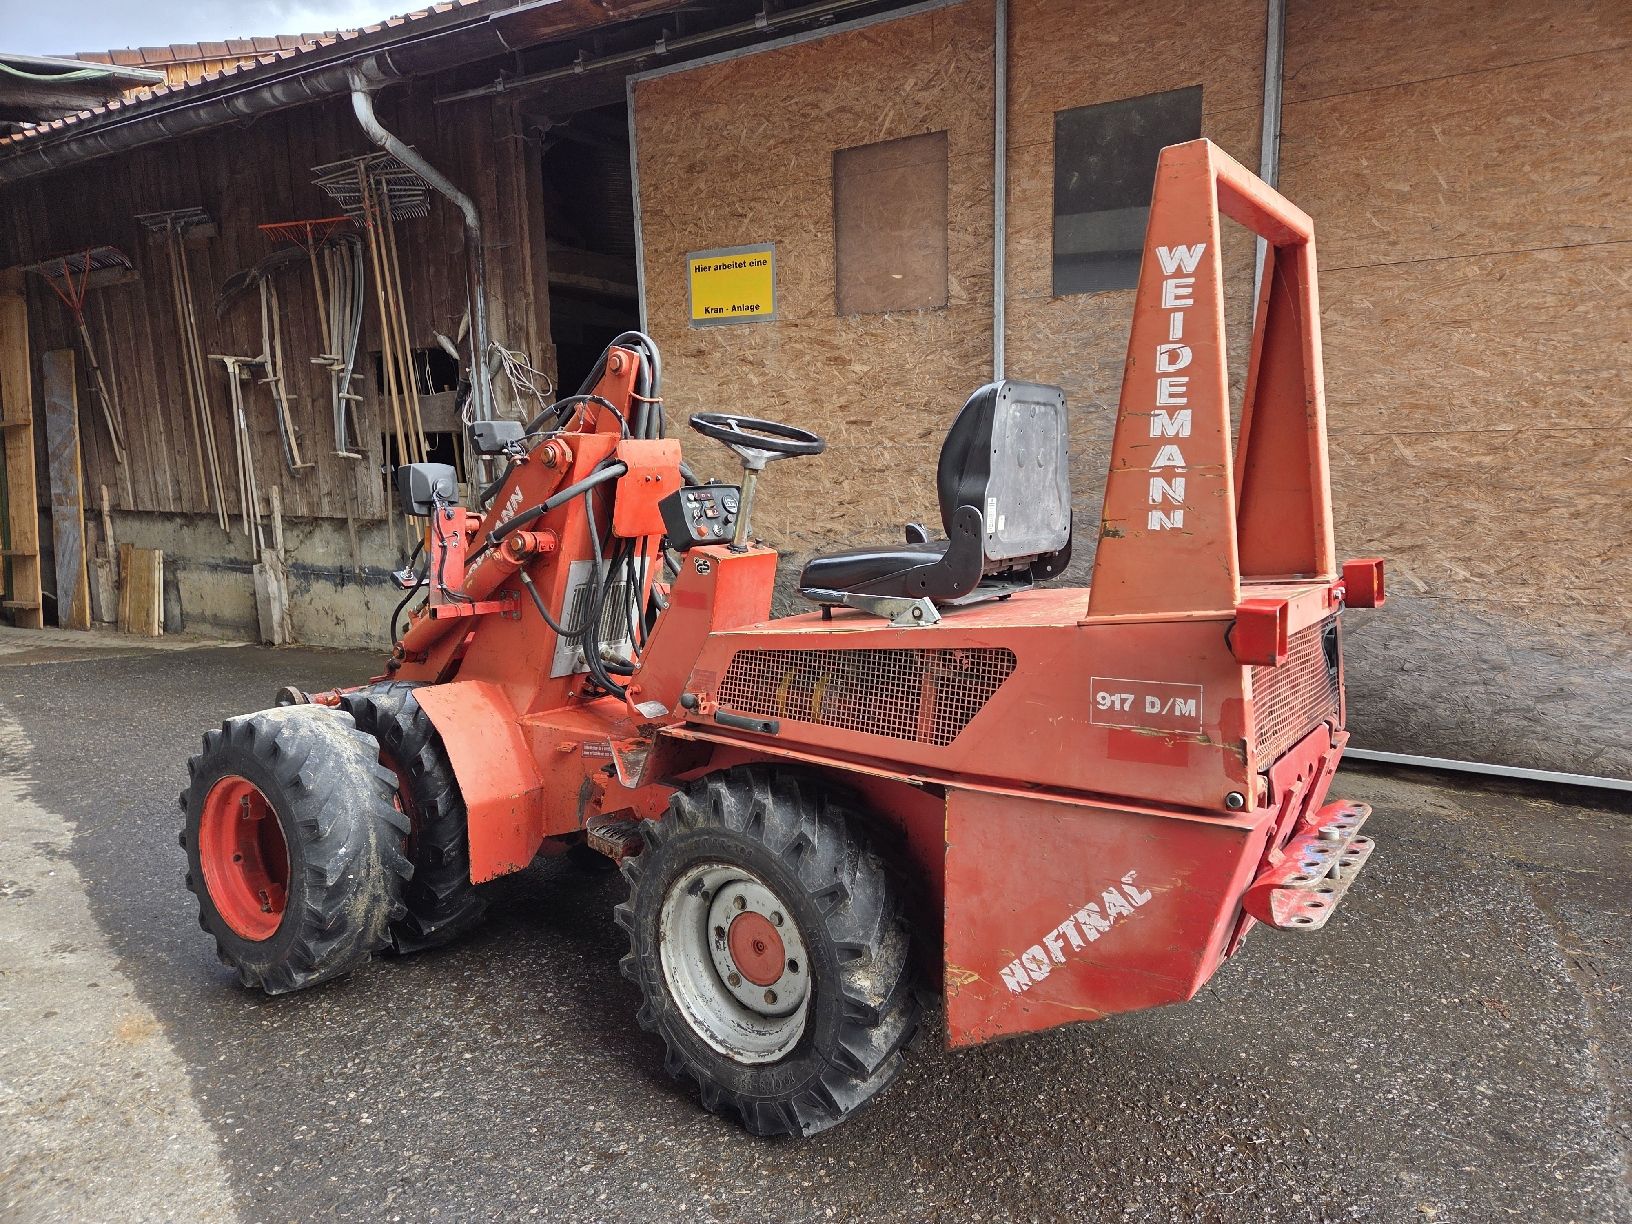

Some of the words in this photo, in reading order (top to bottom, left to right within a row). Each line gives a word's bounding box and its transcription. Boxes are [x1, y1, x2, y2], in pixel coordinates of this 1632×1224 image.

[694, 264, 711, 273] Hier
[713, 260, 746, 271] arbeitet
[749, 258, 767, 267] eine
[704, 306, 724, 314] Kran
[731, 303, 761, 312] Anlage
[1147, 243, 1207, 531] WEIDEMANN
[1096, 691, 1135, 712] 917
[1145, 695, 1196, 717] D/M
